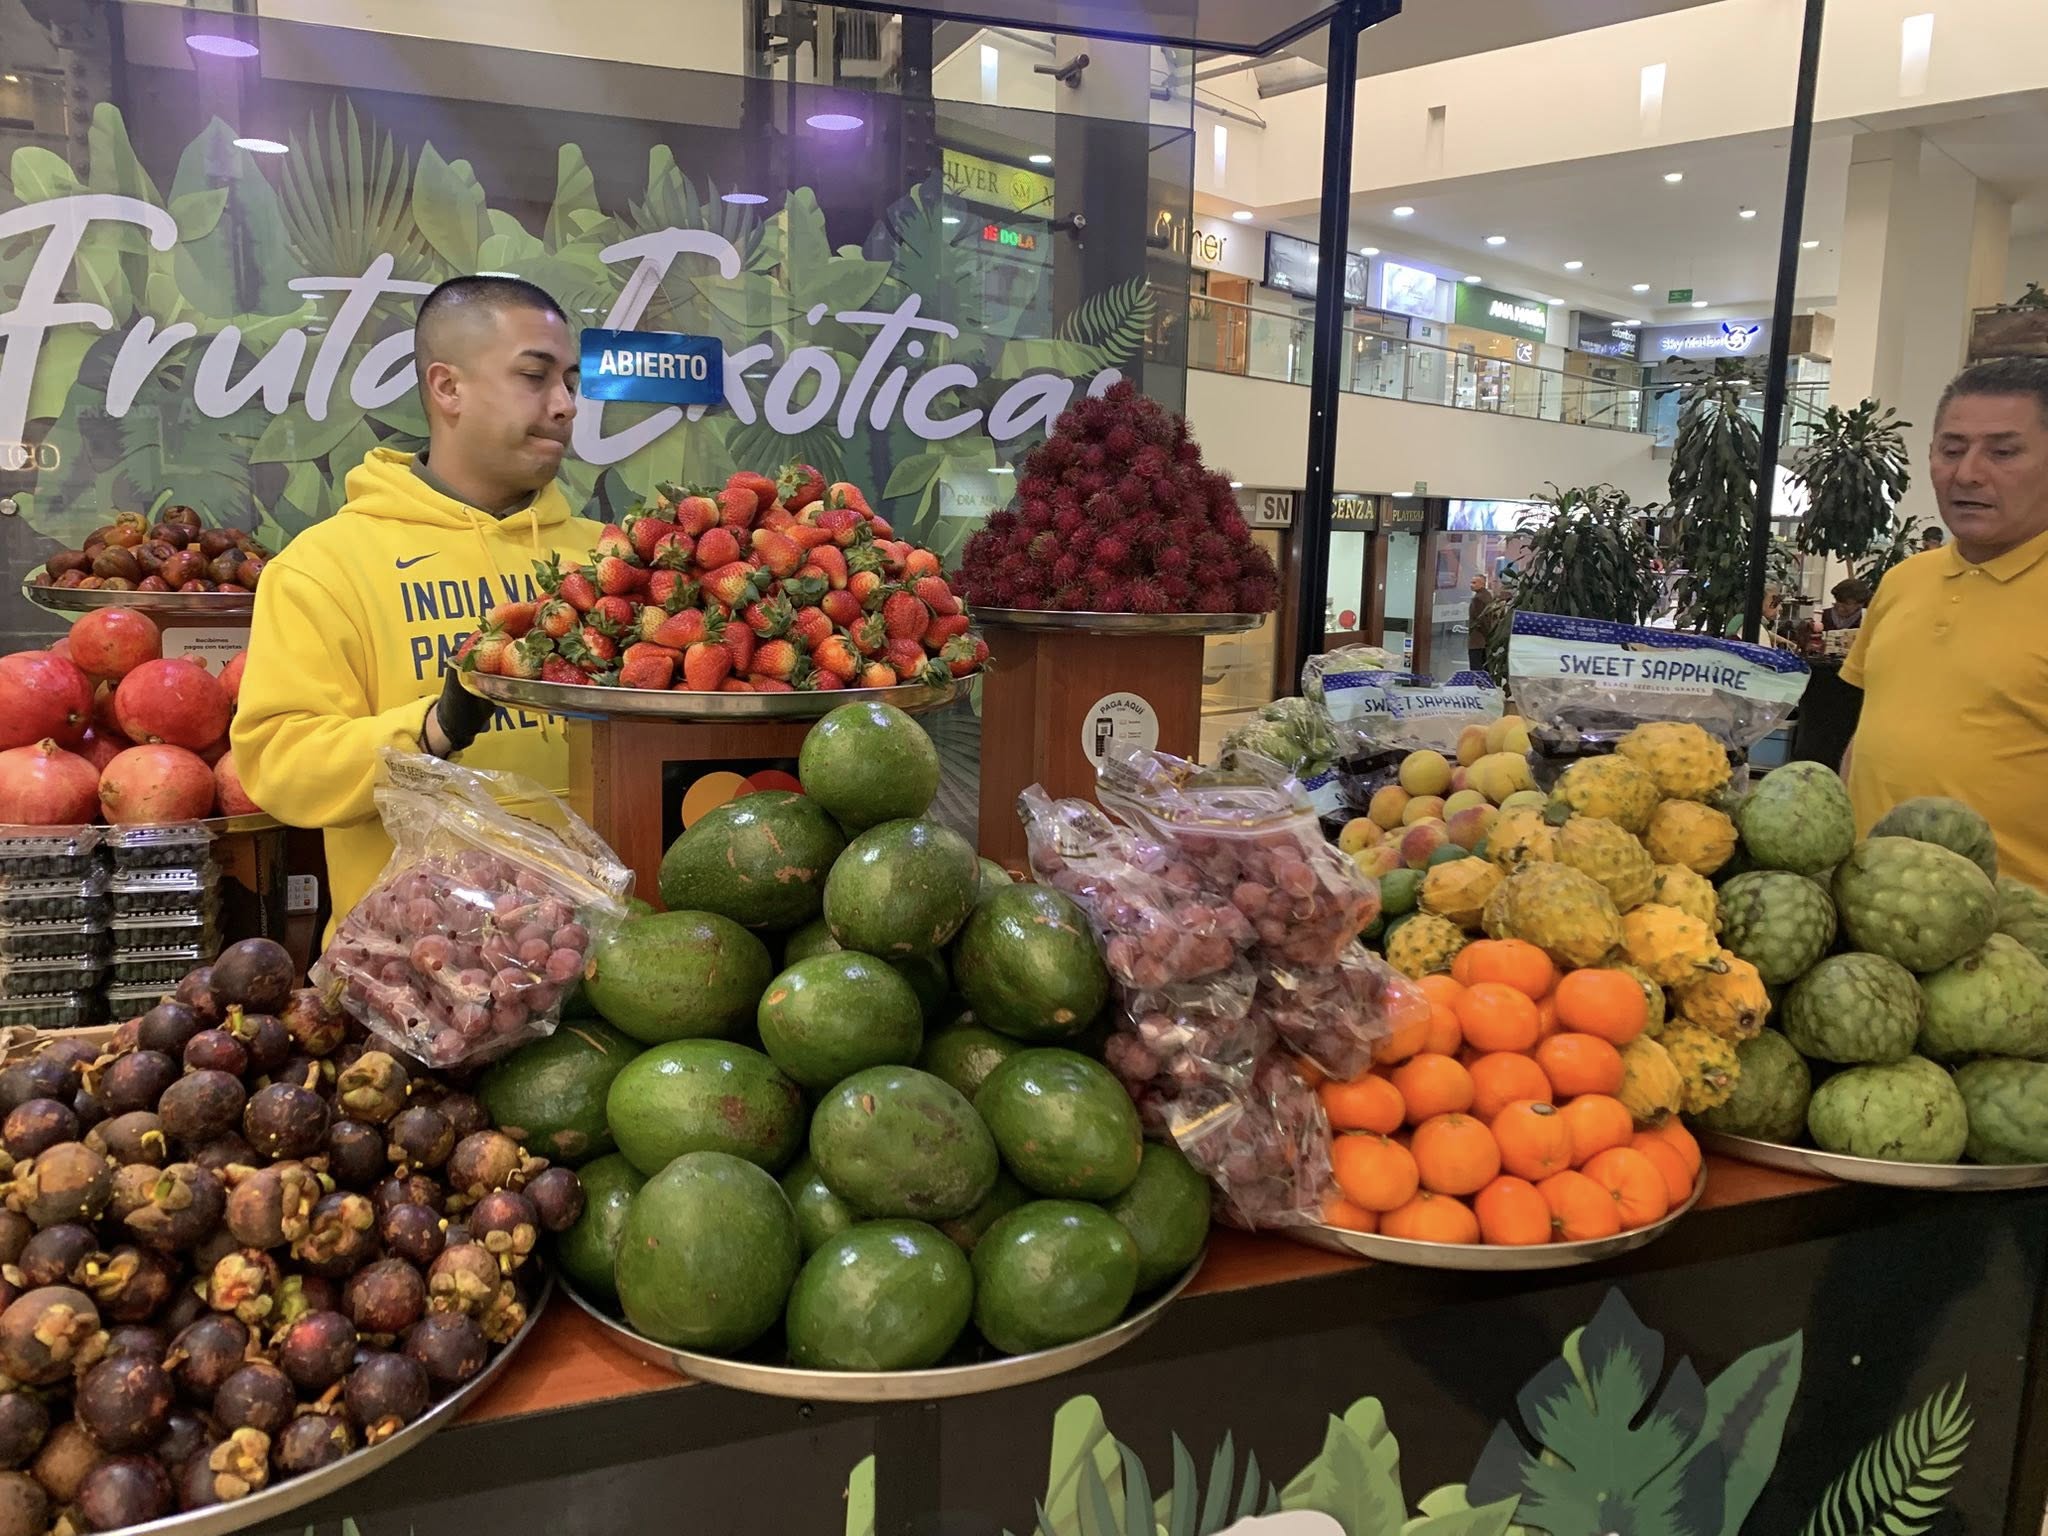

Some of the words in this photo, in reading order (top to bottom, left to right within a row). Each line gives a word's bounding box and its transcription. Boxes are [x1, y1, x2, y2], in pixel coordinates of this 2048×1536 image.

[572, 226, 1123, 465] Exótica
[1661, 338, 1683, 352] Sky
[598, 349, 708, 381] ABIERTO
[1263, 496, 1290, 521] SN
[1560, 654, 1637, 678] SWEET
[1641, 658, 1751, 691] SAPPHIRE
[1633, 684, 1670, 692] SEEDLESS
[1099, 699, 1123, 715] PAGA
[1416, 694, 1485, 711] SAPPHIRE
